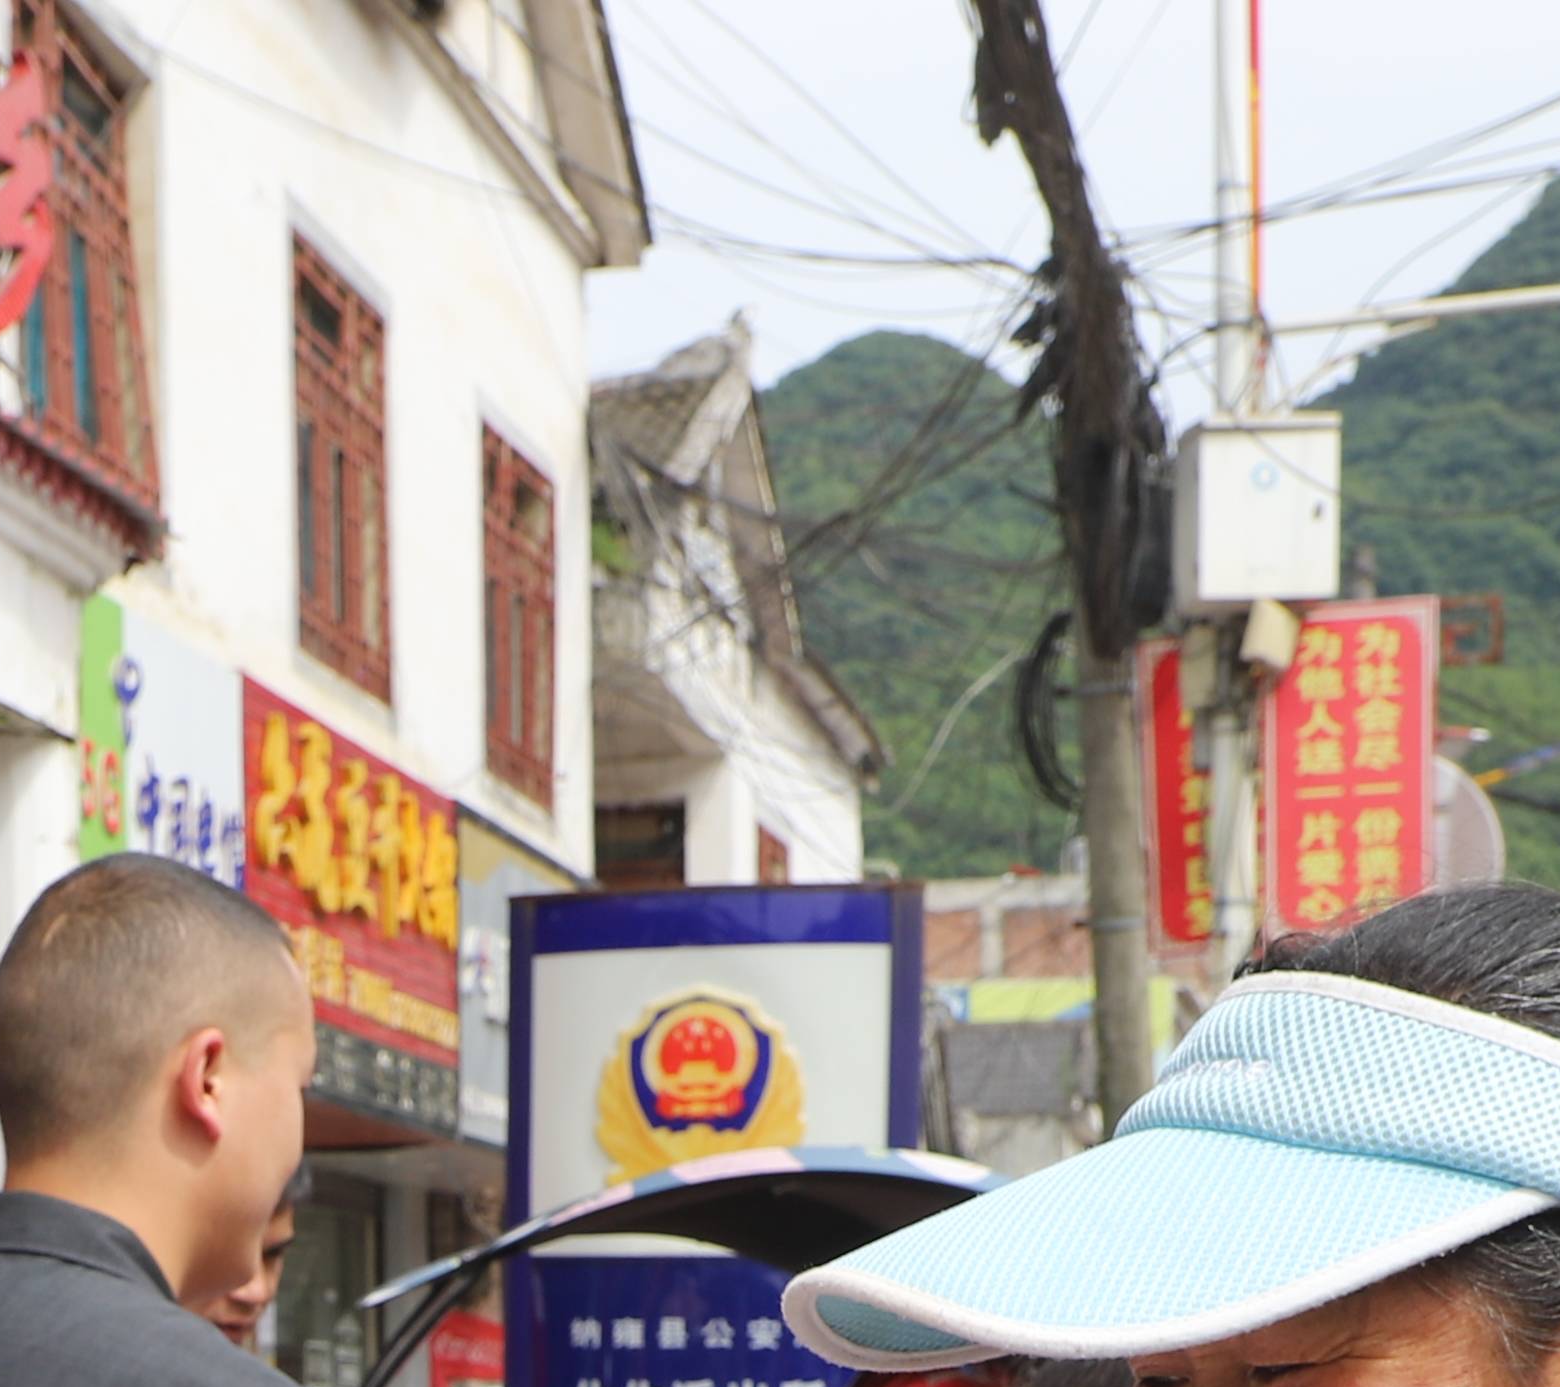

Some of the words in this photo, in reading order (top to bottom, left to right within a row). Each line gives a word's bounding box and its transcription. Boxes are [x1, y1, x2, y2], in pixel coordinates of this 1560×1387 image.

[570, 1315, 806, 1351] 纳雍县公安
